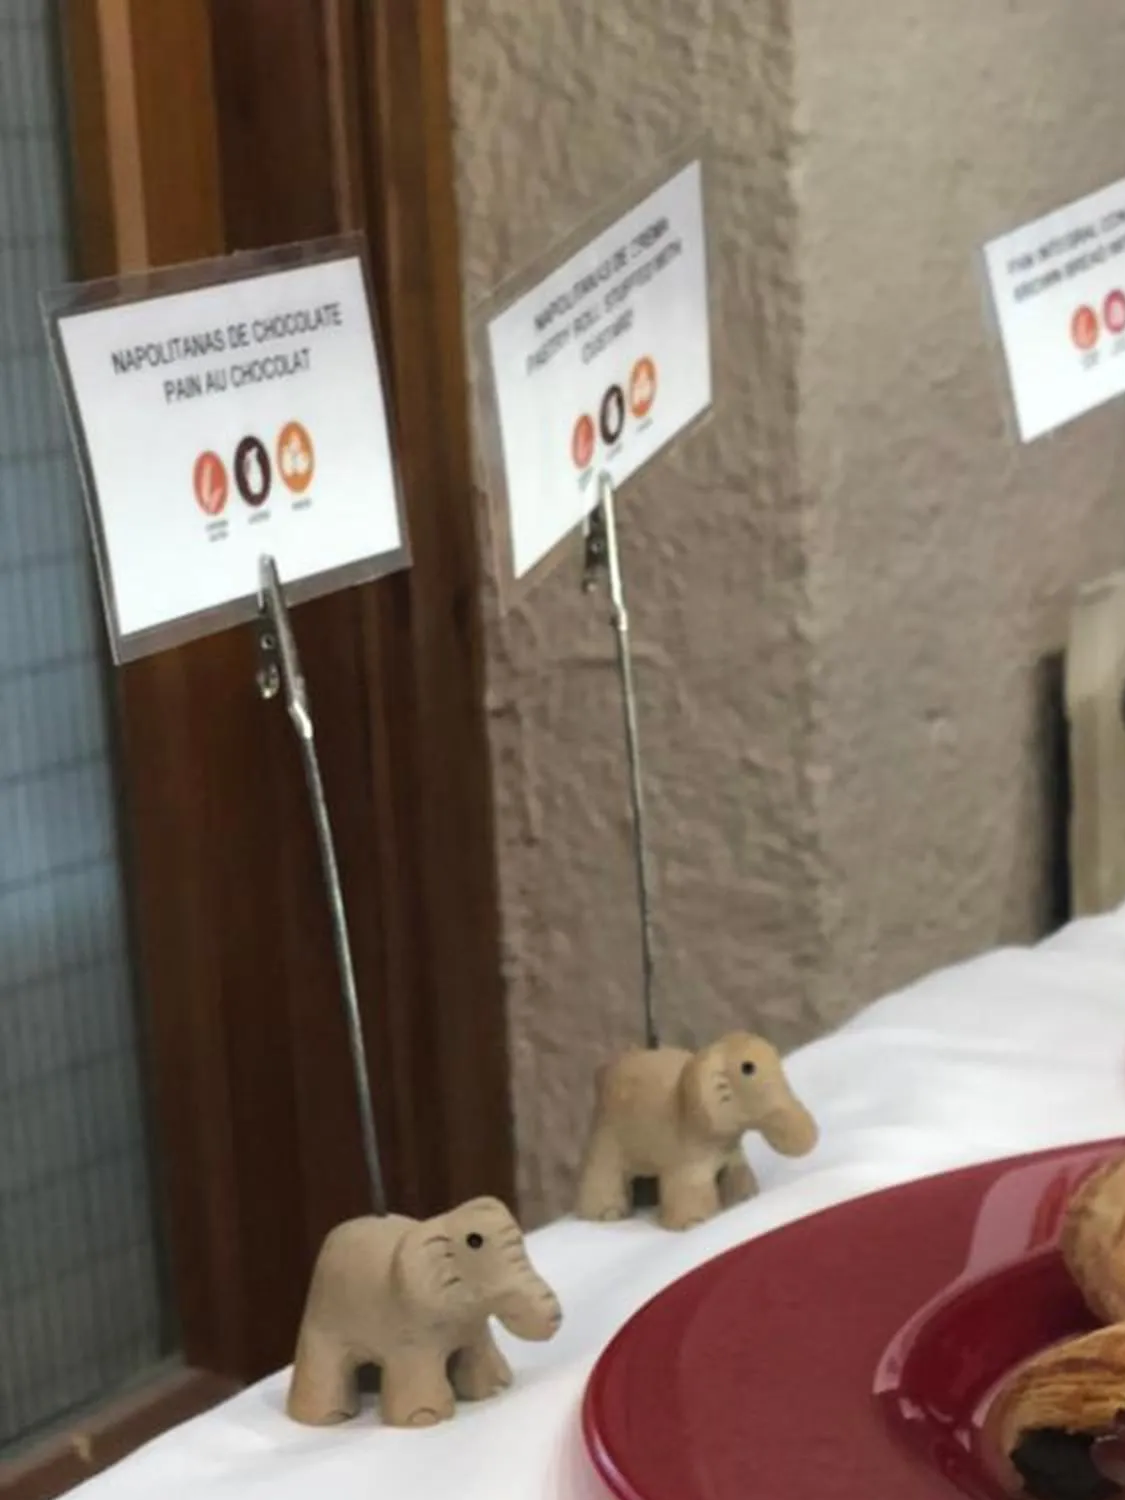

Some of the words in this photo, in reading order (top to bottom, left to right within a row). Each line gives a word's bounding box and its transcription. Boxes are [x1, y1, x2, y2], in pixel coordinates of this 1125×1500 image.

[111, 328, 225, 374] NAPOLITANAS
[226, 323, 250, 350] DE
[251, 302, 343, 343] CHOCOLATE
[163, 374, 203, 404] PAIN
[205, 367, 228, 393] AU
[230, 348, 311, 387] CHOCOLAT
